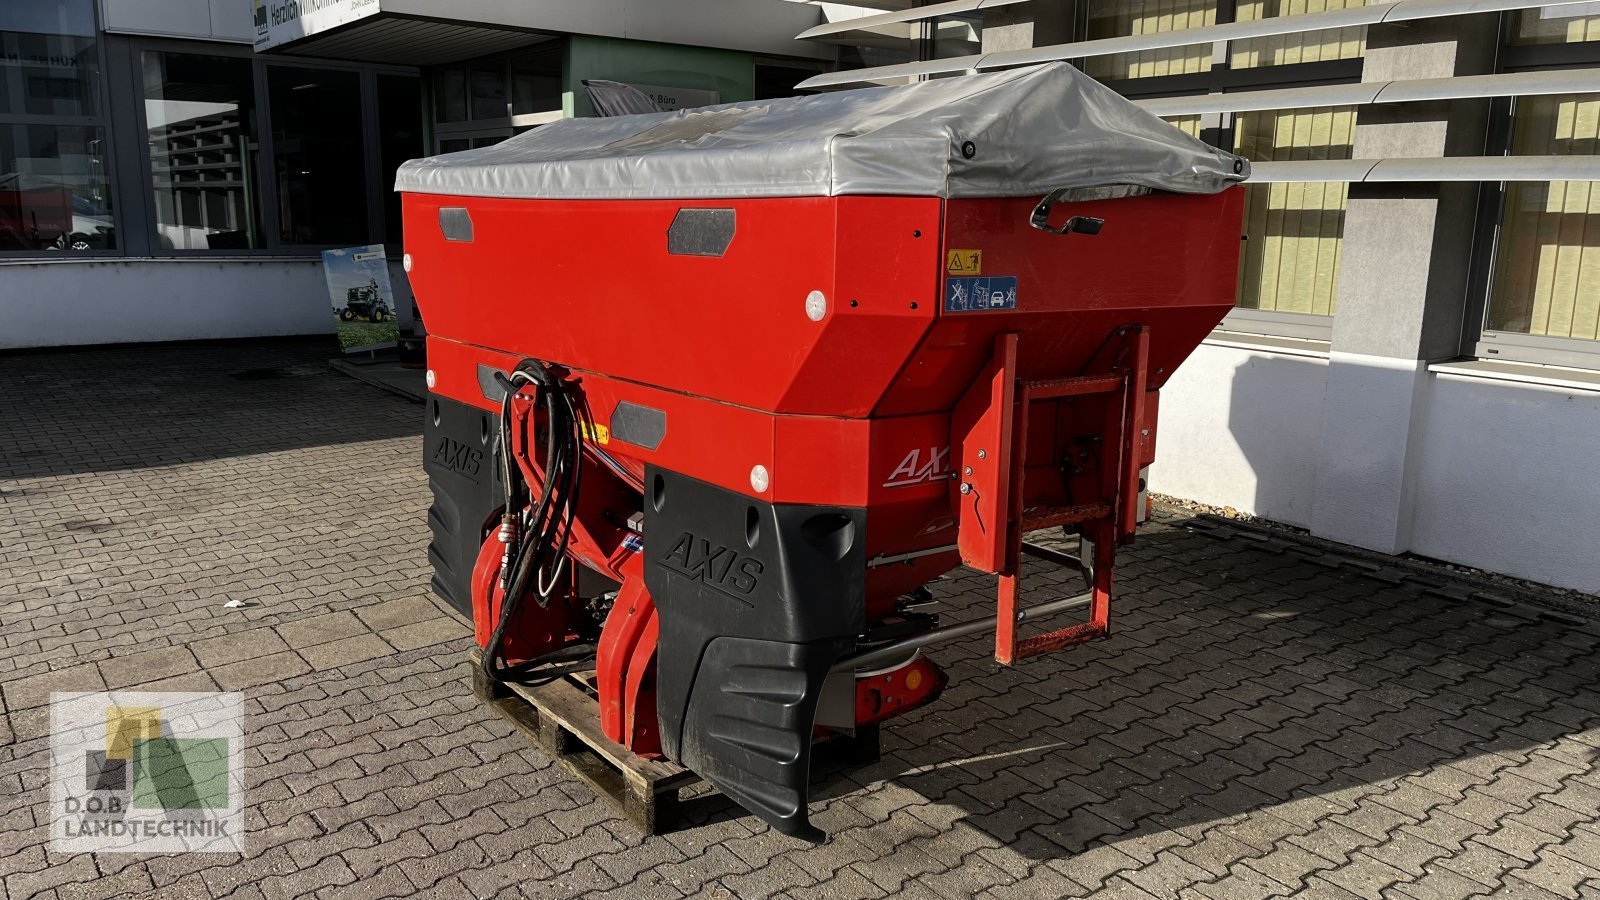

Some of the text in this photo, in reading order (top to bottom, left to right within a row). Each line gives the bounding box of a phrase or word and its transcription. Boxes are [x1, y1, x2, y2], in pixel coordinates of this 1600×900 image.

[658, 94, 676, 104] Büro
[434, 437, 483, 477] AXIS
[888, 446, 950, 480] AX
[661, 531, 765, 596] AXIS
